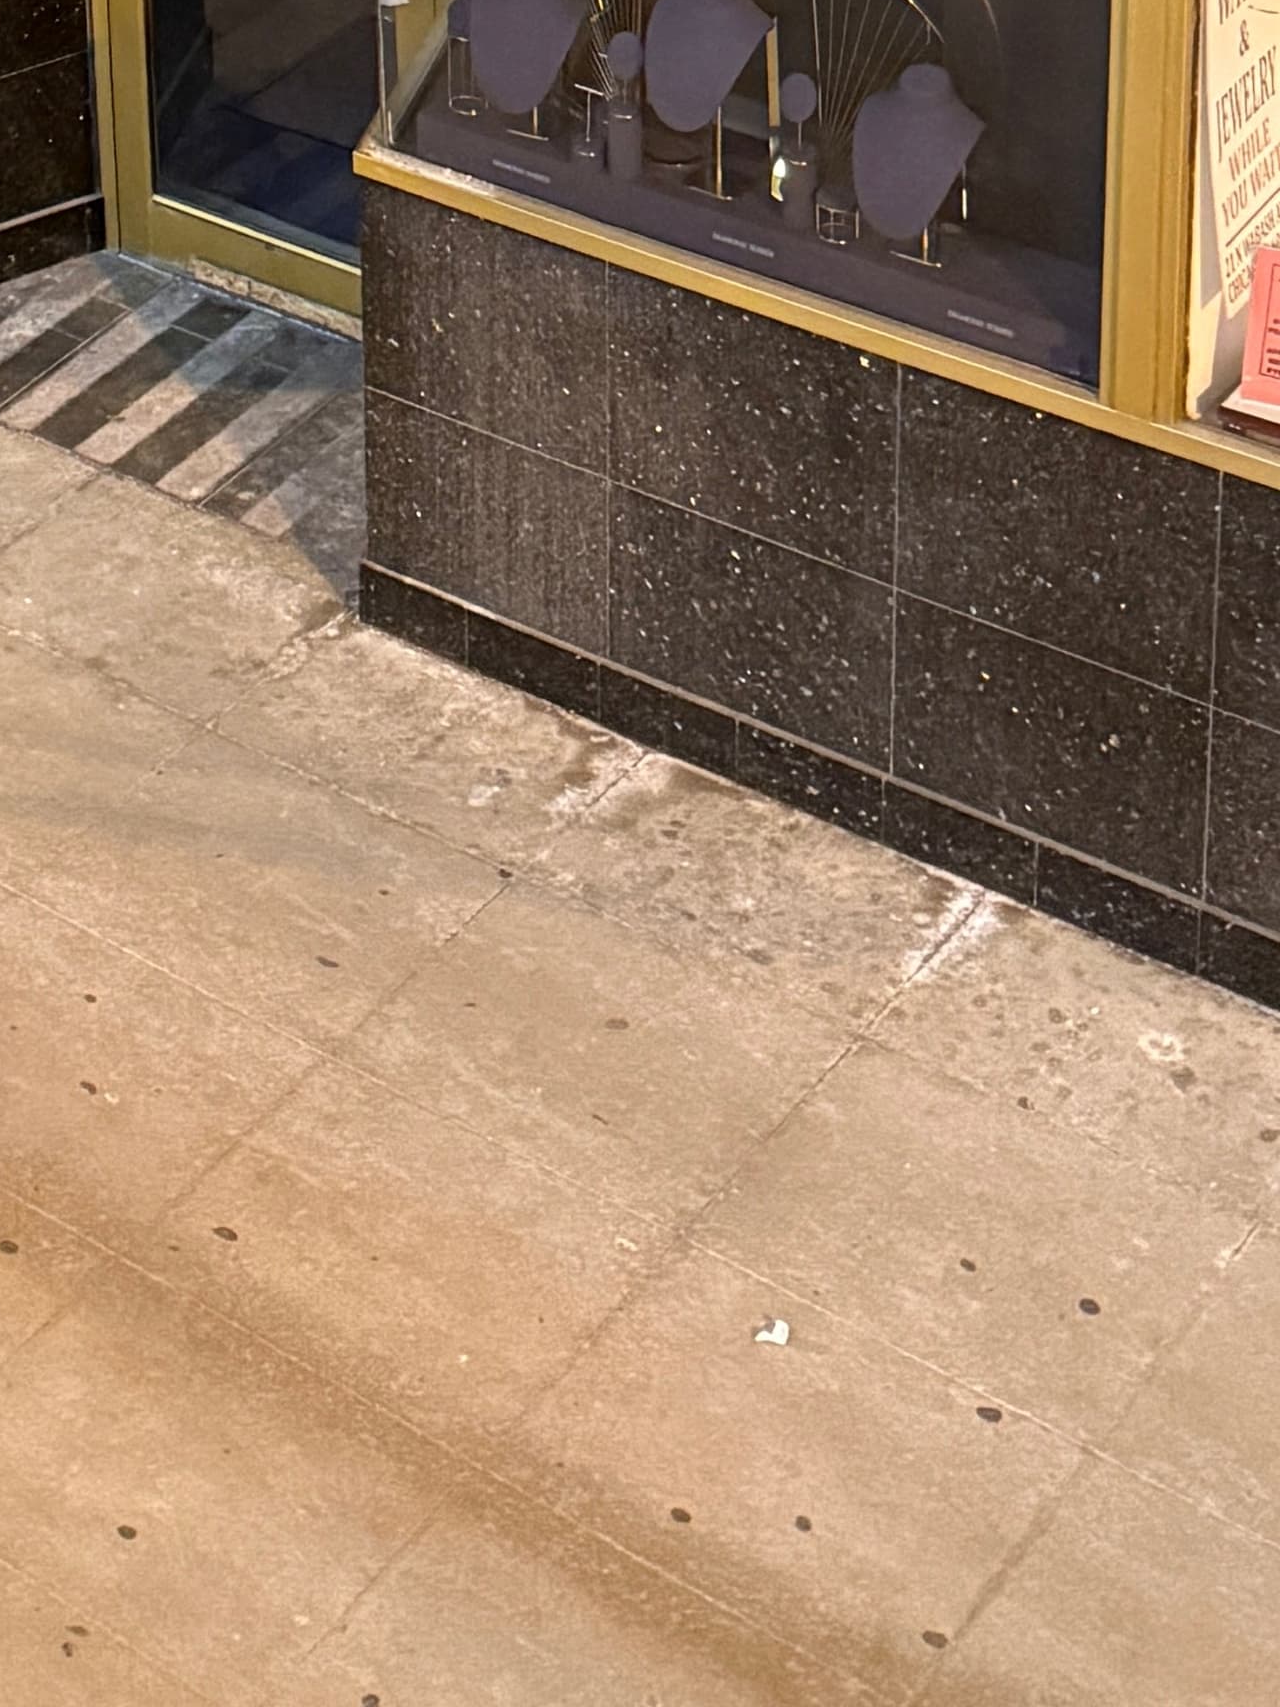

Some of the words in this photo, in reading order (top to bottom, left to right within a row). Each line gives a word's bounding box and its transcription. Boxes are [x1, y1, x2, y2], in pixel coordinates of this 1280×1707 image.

[1239, 18, 1250, 57] &
[1215, 44, 1277, 164] JEWELRY
[1228, 117, 1272, 182] WHILE
[1222, 178, 1249, 228] YOU
